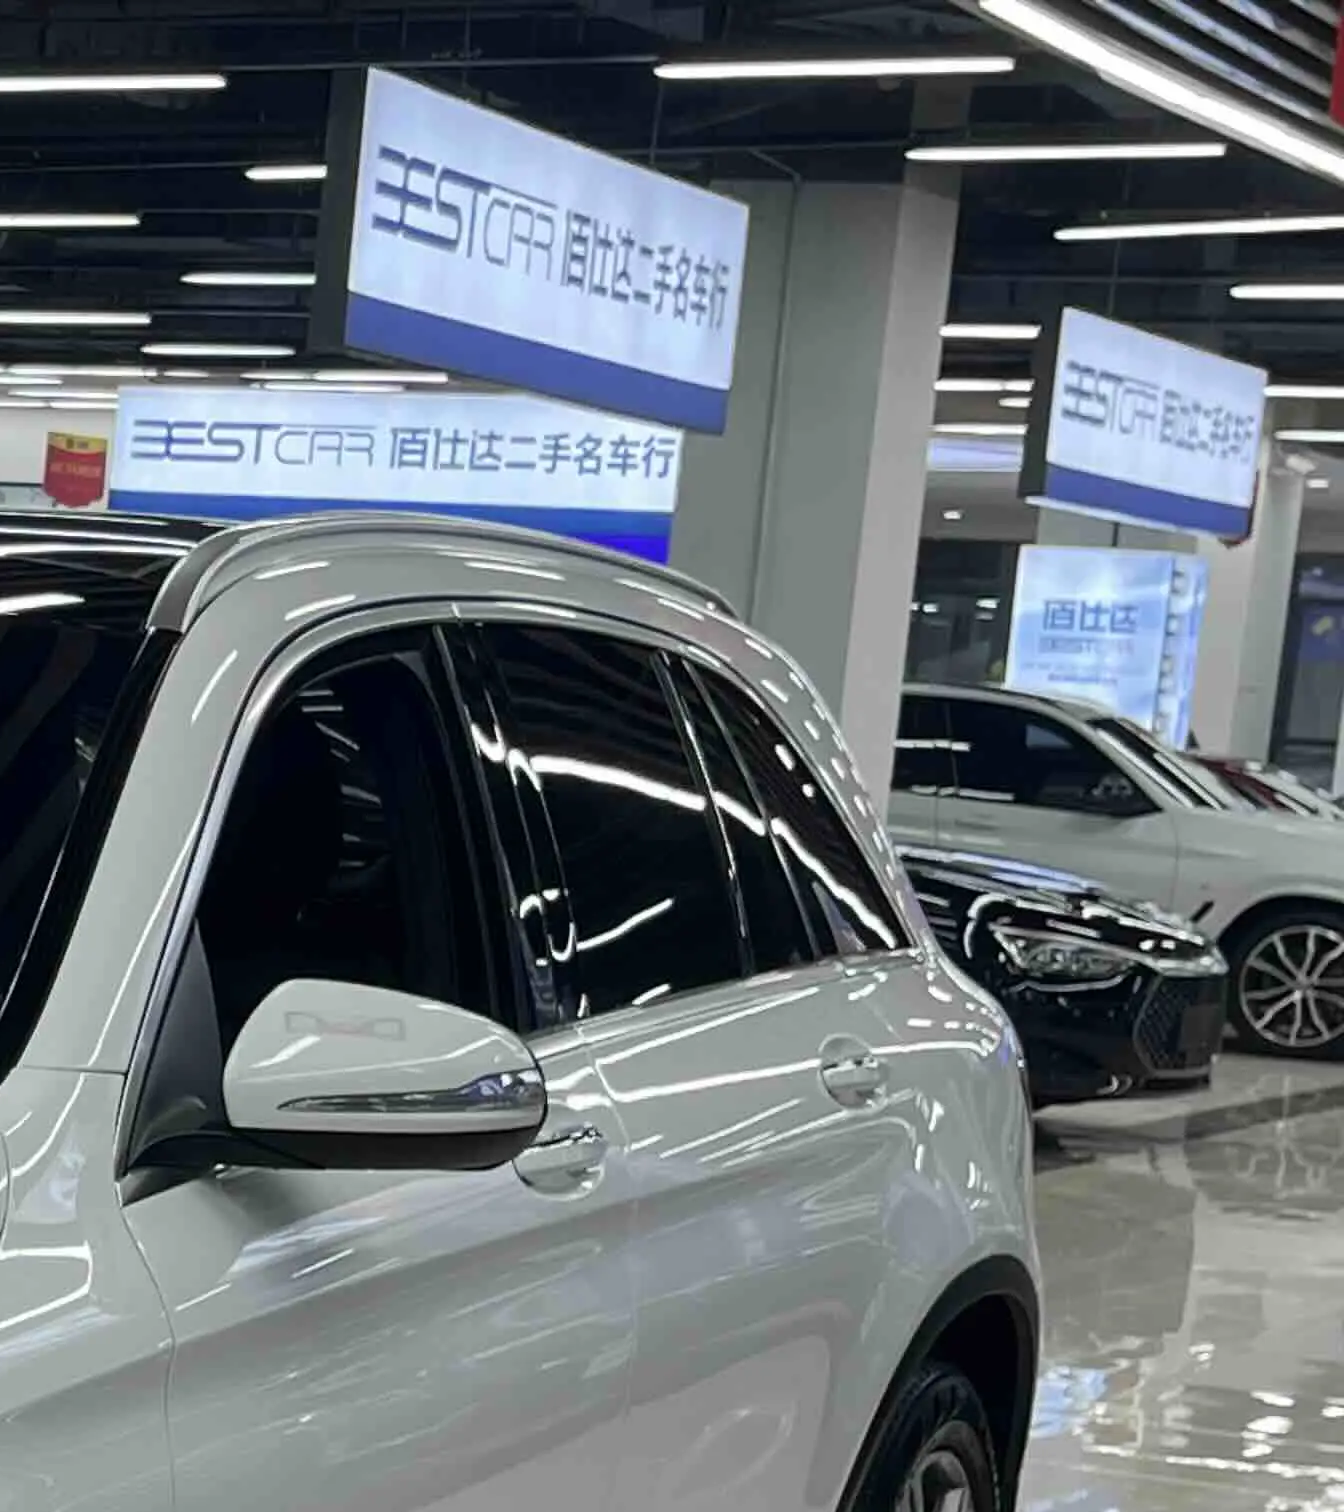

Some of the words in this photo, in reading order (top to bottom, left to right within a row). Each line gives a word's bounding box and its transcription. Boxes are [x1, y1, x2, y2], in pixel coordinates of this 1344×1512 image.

[389, 426, 677, 479] 佰仕达二手名车行
